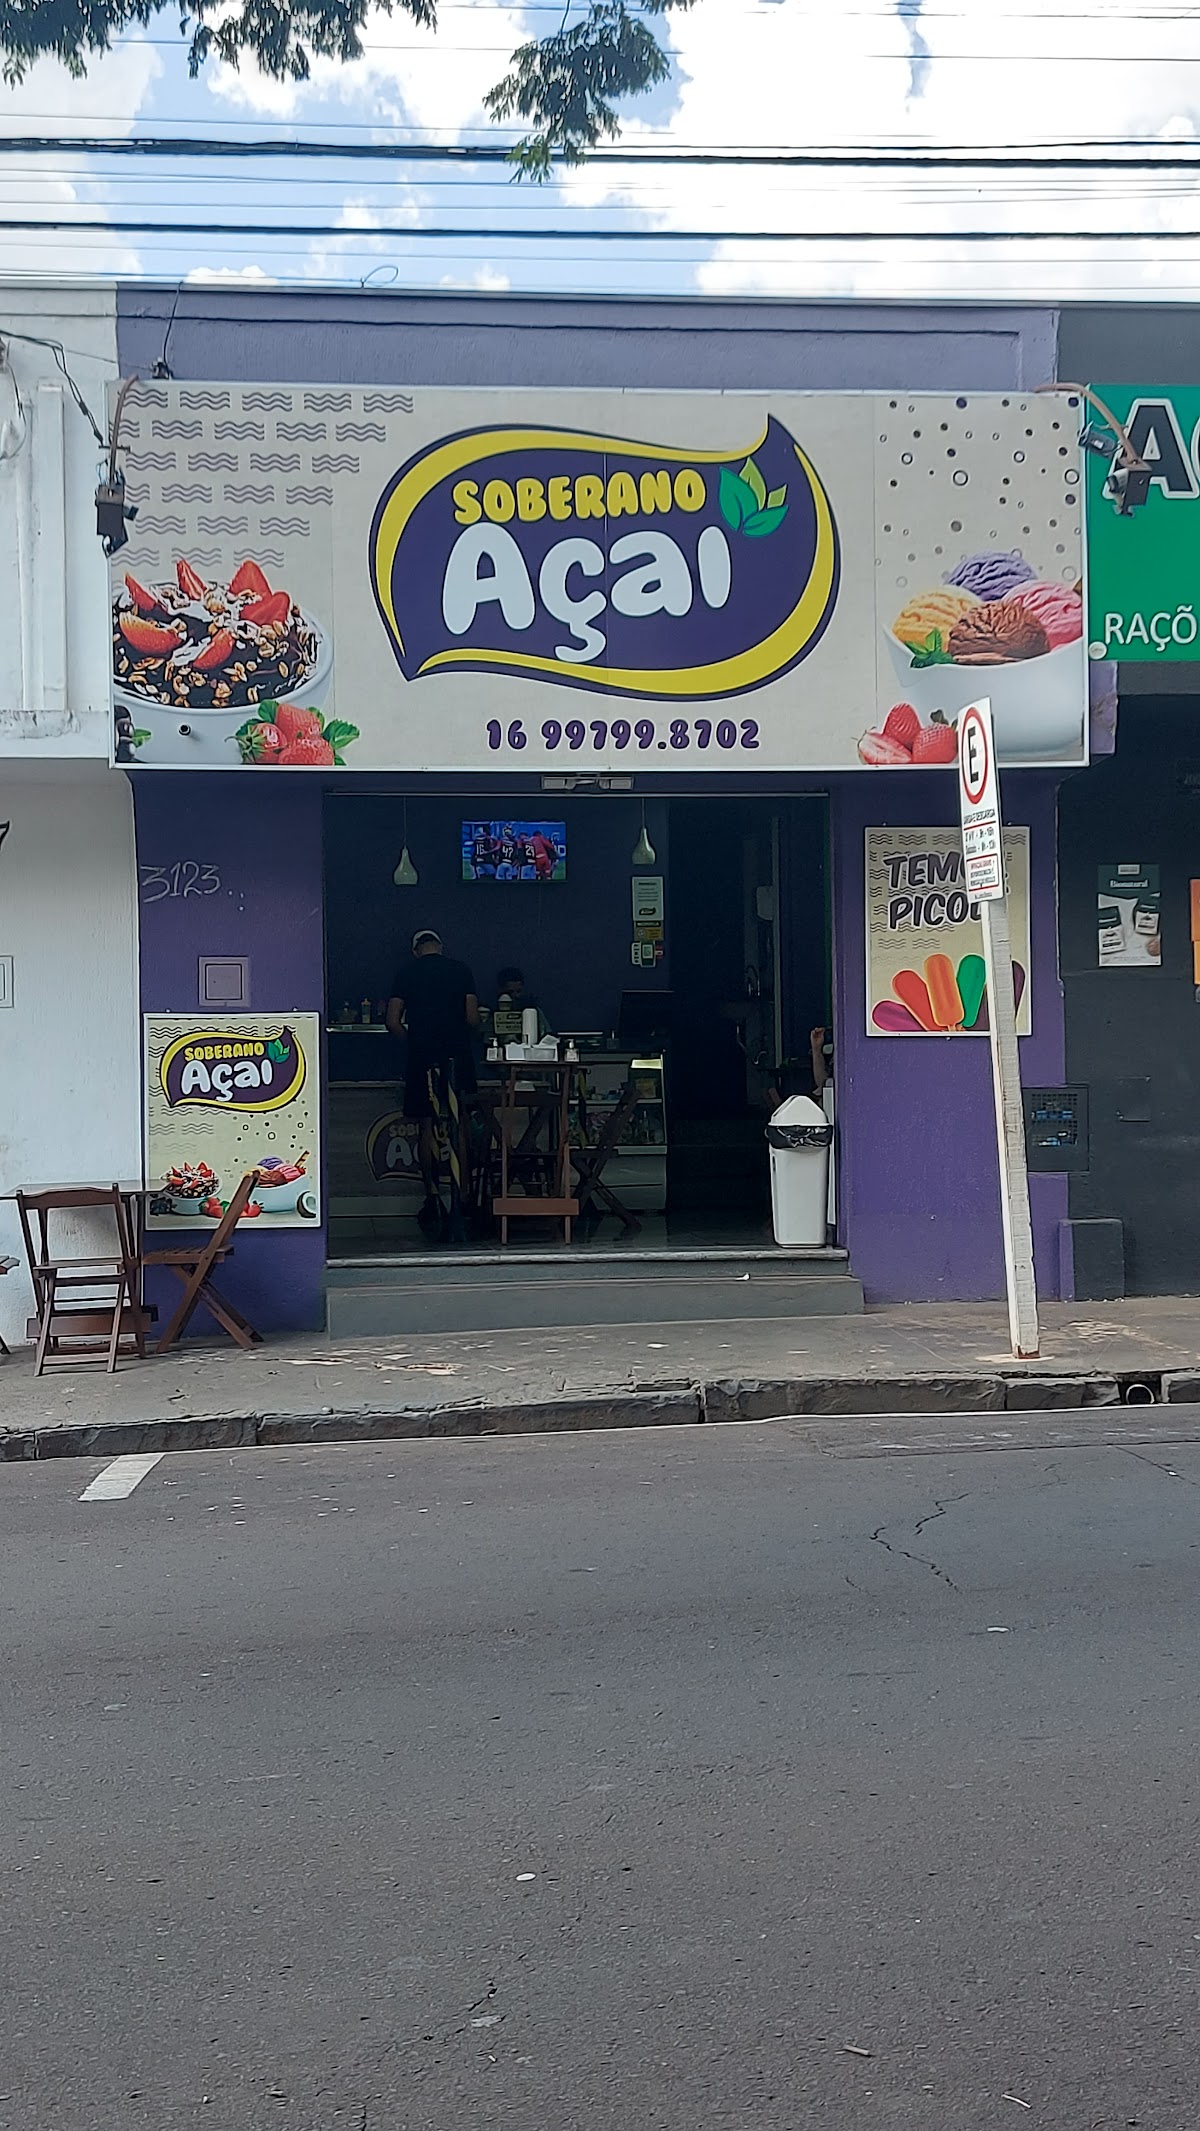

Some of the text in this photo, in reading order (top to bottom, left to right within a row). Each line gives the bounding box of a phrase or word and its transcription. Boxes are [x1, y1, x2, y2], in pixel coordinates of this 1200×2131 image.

[1102, 398, 1200, 500] A
[452, 468, 707, 525] SOBERANO
[486, 718, 760, 750] 16 99799.8702
[967, 725, 980, 785] E
[883, 851, 966, 889] TEM
[184, 1042, 265, 1062] SOBERANO
